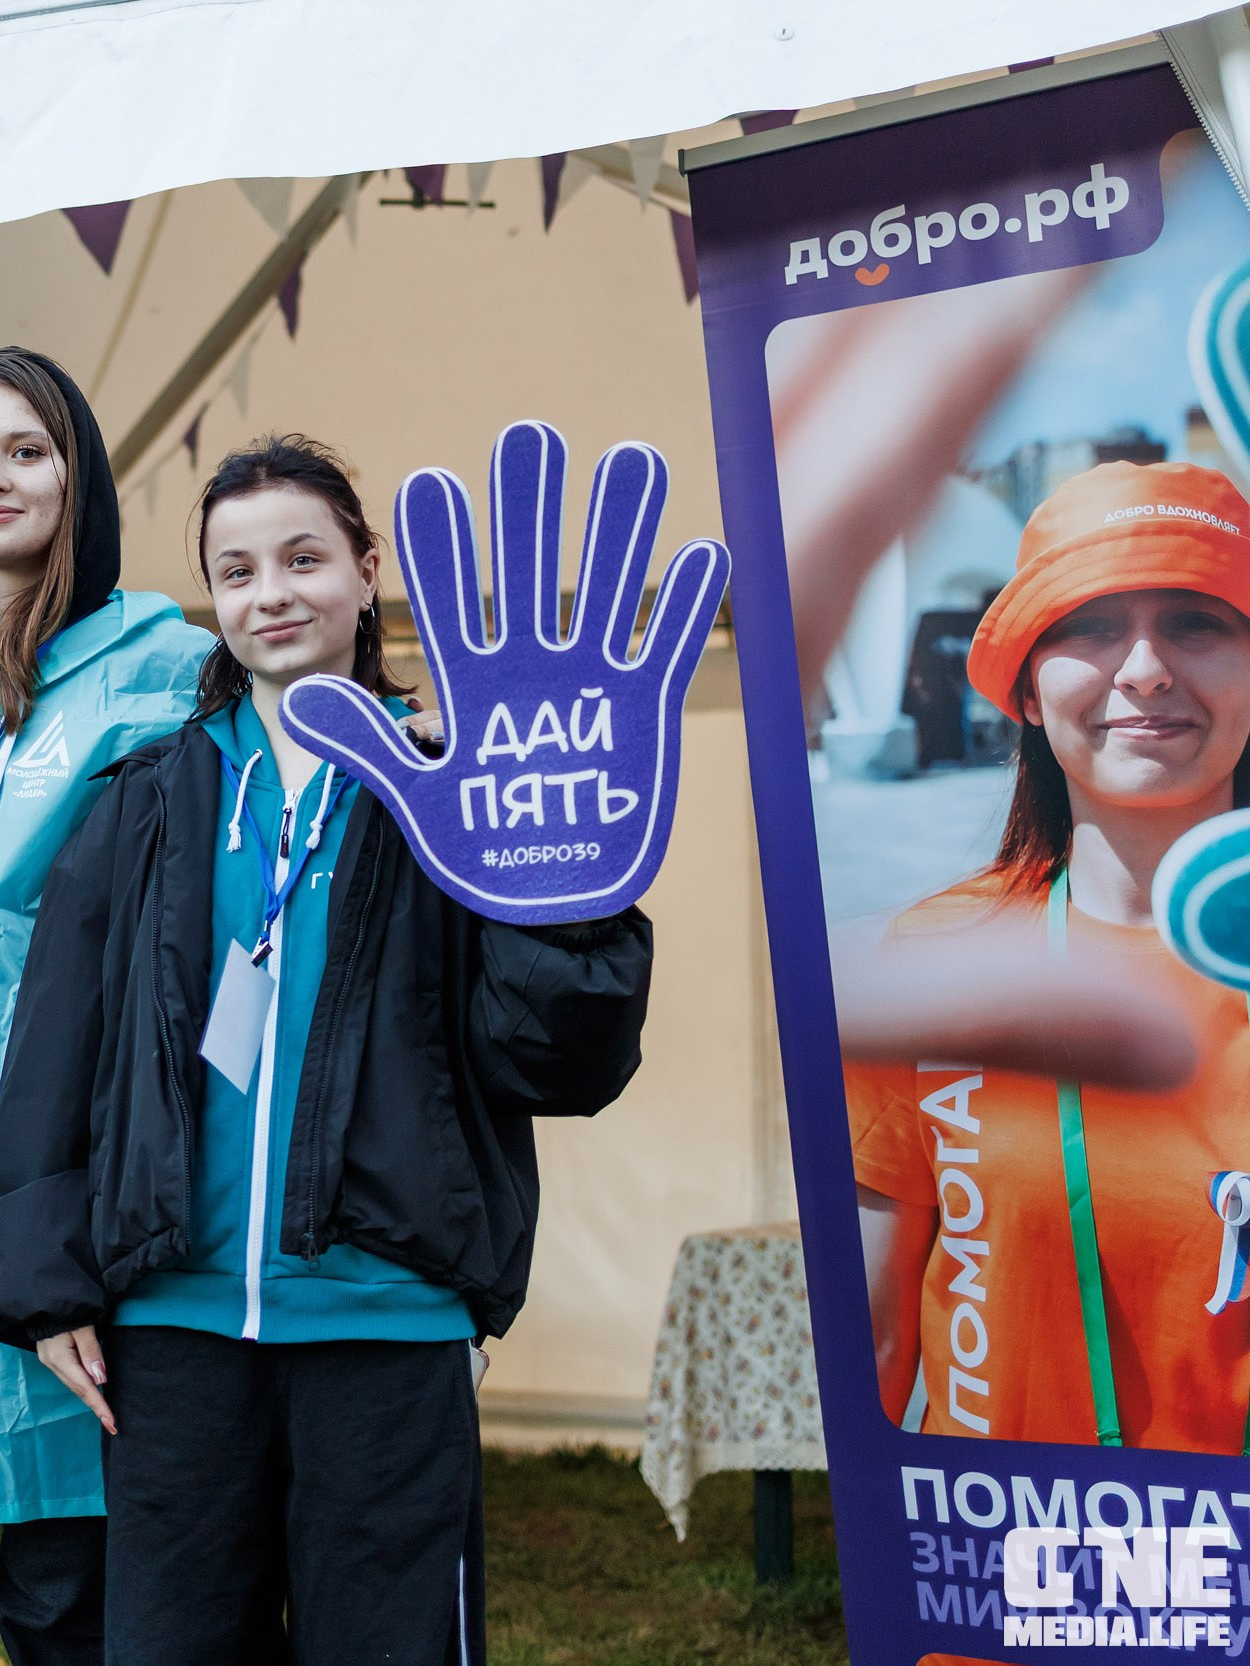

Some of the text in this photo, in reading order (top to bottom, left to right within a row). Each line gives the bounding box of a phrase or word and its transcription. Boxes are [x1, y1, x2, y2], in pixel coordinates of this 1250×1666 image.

[784, 163, 1130, 286] добро.рф
[1104, 505, 1240, 535] ДОБРО ВДОХНОВЛЯЕТ
[476, 687, 614, 766] ДАЙ
[459, 768, 640, 831] ПЯТЬ
[481, 842, 601, 869] #ДОБРО39
[917, 1060, 991, 1434] ПОМОГА
